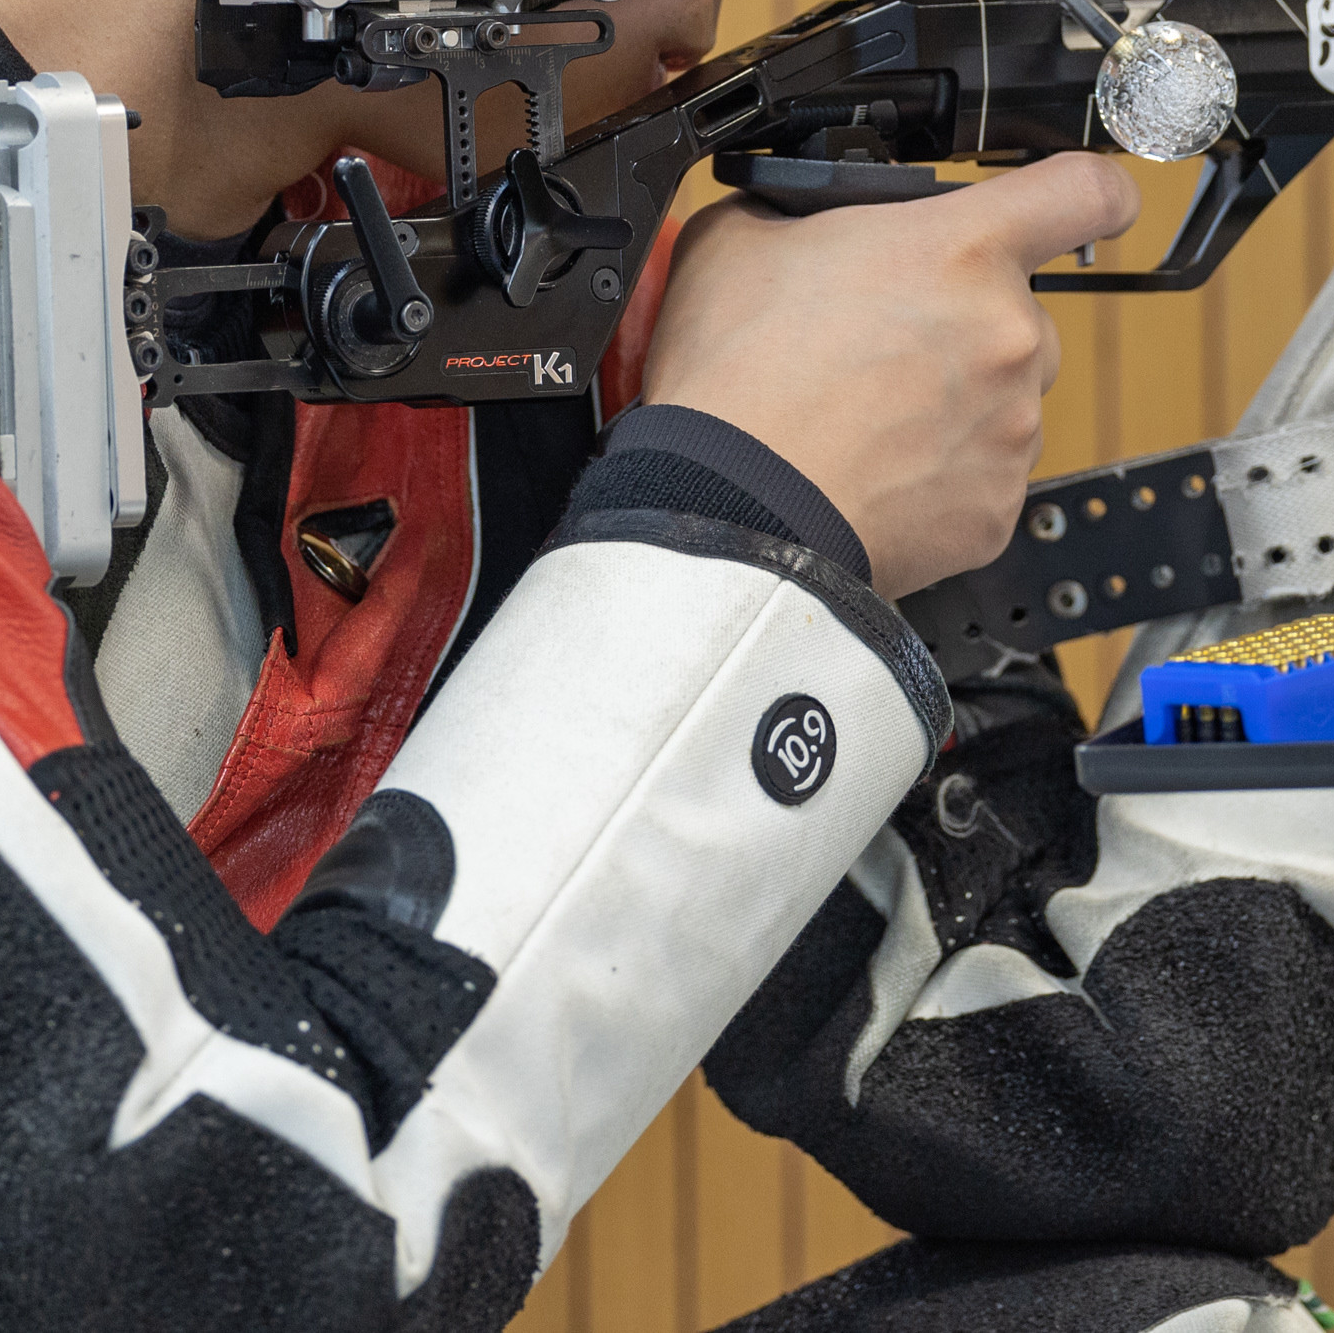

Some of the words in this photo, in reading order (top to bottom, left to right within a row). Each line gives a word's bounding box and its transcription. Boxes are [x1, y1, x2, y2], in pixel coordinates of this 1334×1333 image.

[445, 354, 532, 370] PROJECT
[533, 351, 573, 385] K1
[777, 709, 826, 778] 10.9
